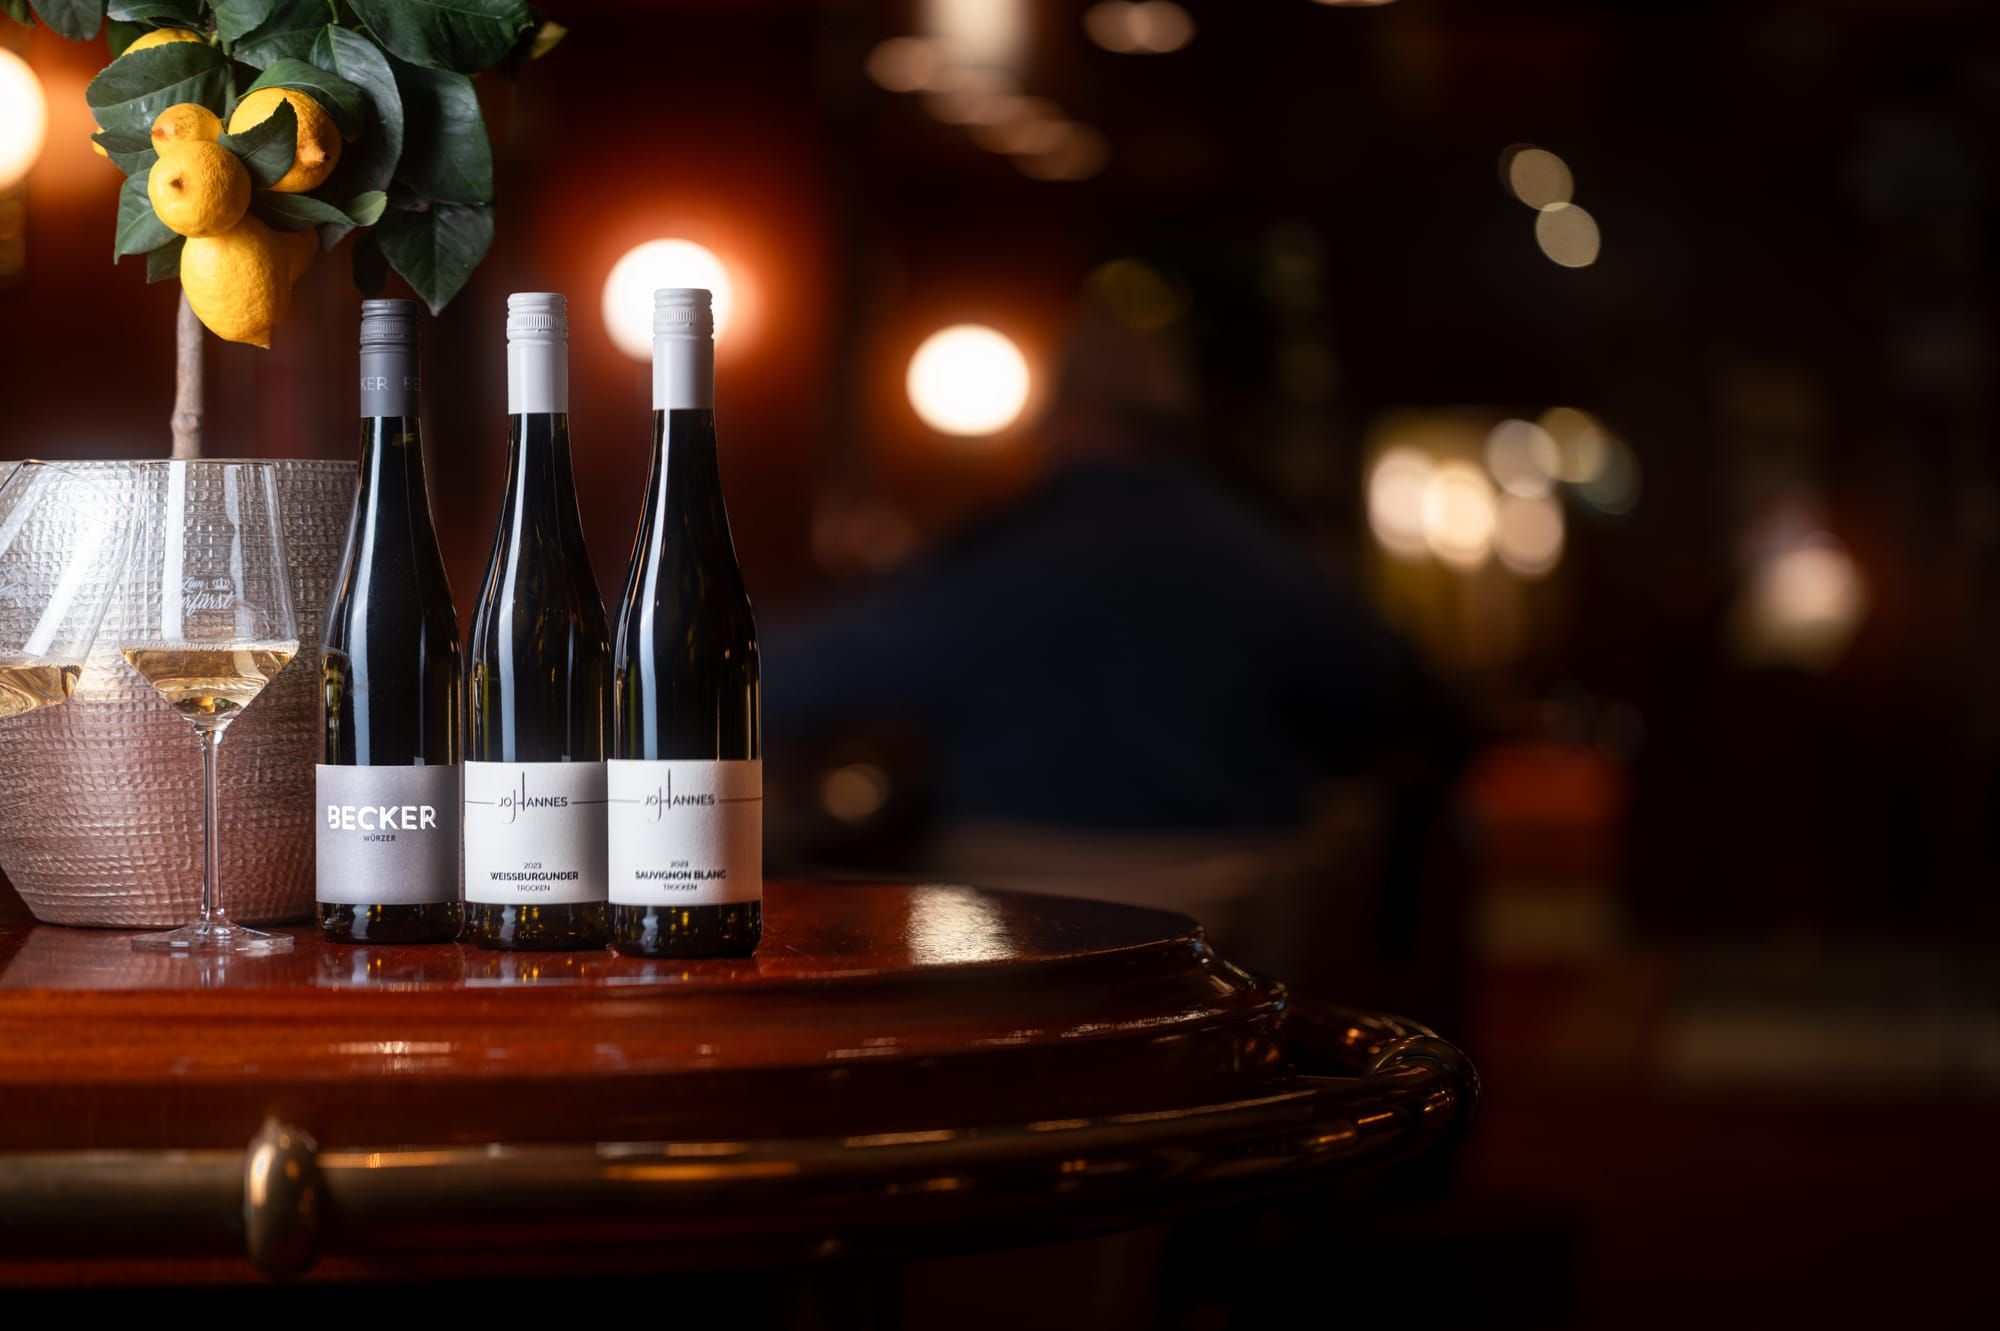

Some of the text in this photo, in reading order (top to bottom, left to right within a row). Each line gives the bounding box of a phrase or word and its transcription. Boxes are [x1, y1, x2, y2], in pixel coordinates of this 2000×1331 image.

[327, 805, 437, 830] BECKER
[362, 834, 397, 842] WÜRZER
[523, 861, 542, 869] 2023
[490, 871, 579, 881] WEISSBURGUNDER
[635, 869, 727, 880] SAUVIGNON BLANC
[516, 884, 550, 892] TROCKEN
[663, 882, 698, 891] TROCKEN
